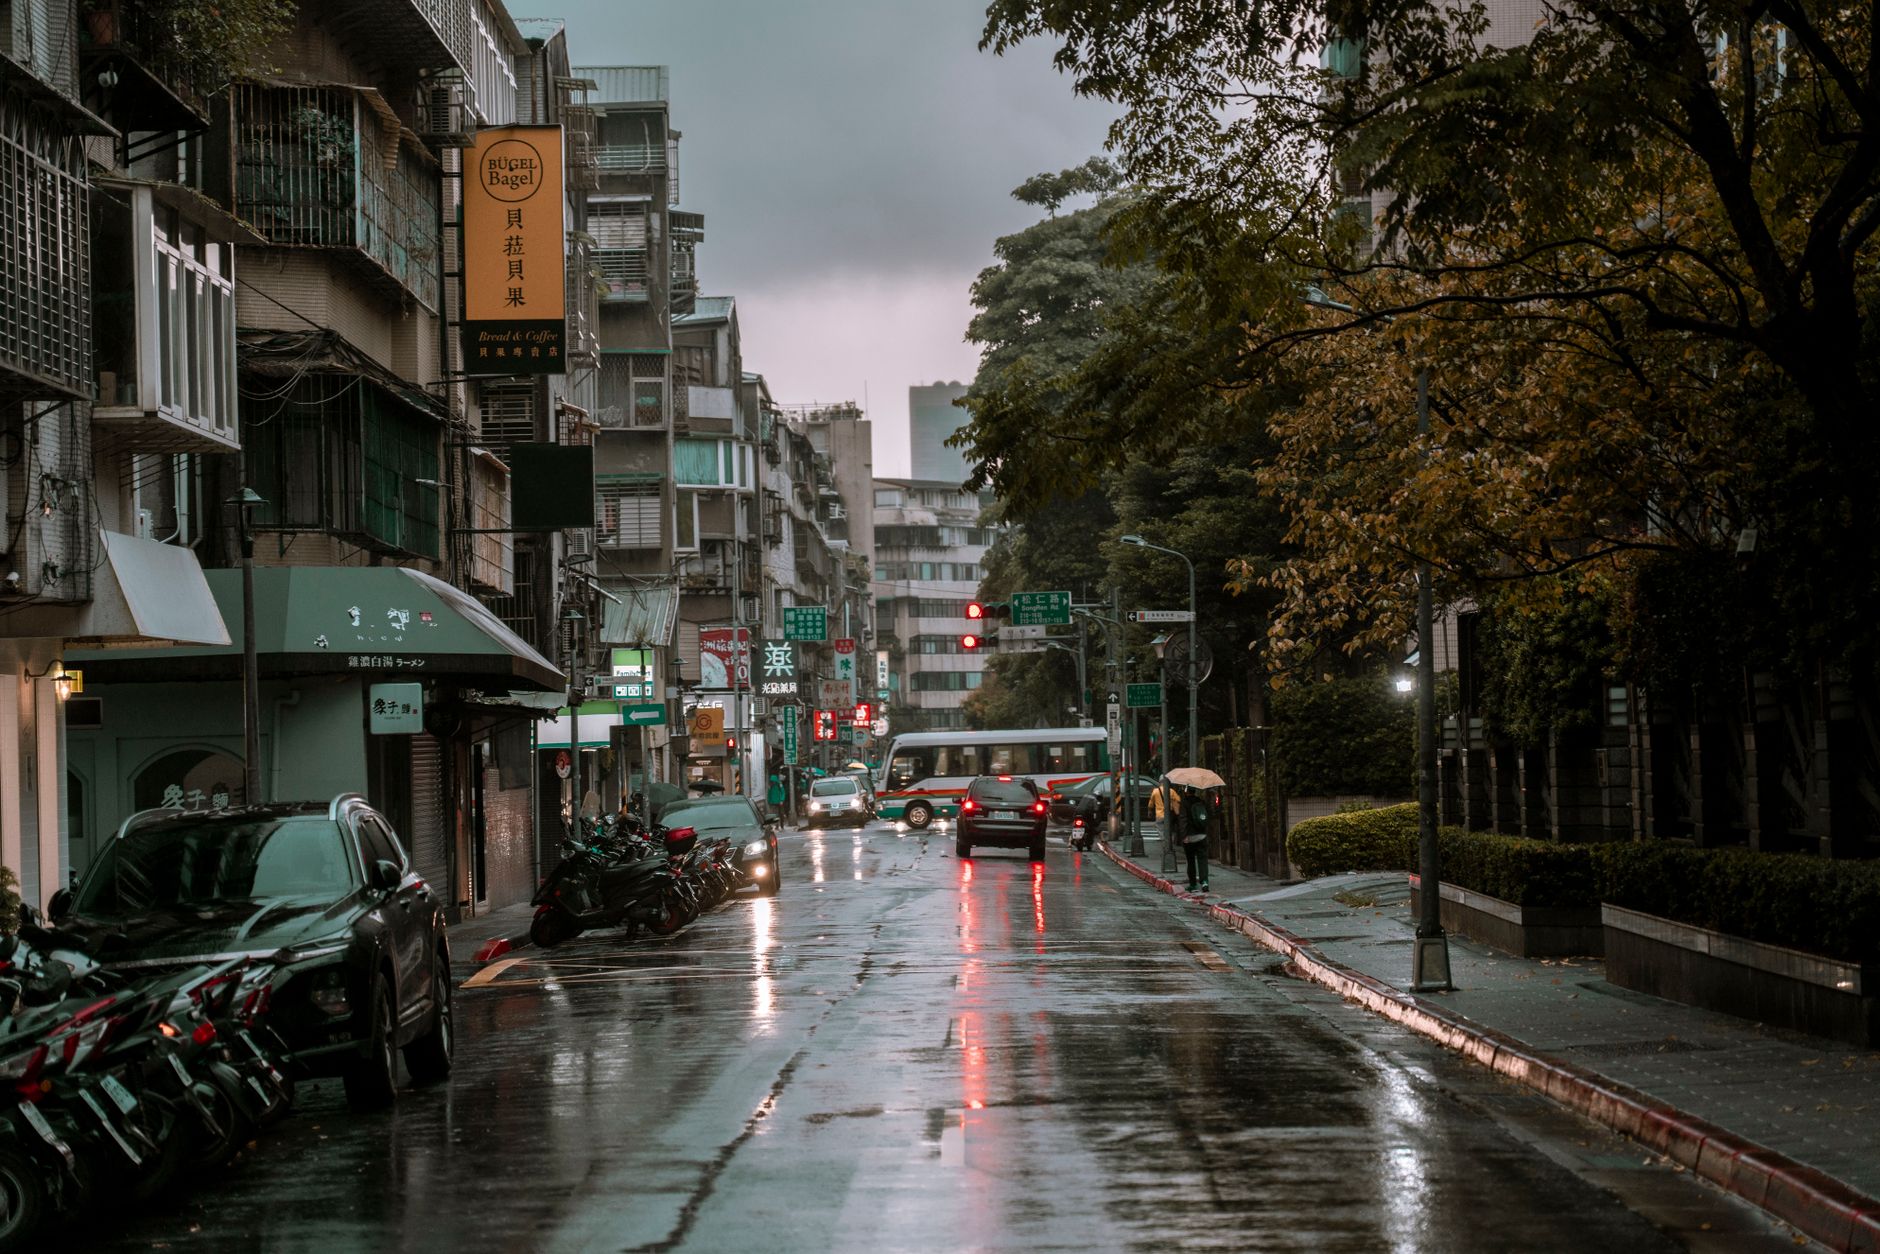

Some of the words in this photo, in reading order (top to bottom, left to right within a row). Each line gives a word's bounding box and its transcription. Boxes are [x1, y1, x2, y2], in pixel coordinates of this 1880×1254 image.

[488, 156, 538, 172] BÜGEL
[488, 170, 534, 190] Bagel
[502, 208, 527, 309] 貝菈貝果
[479, 330, 511, 342] Bread
[512, 331, 523, 342] &
[525, 329, 558, 345] Coffee
[1022, 594, 1060, 605] 松仁路
[395, 657, 425, 668] ラーメン
[616, 670, 651, 678] Familyt
